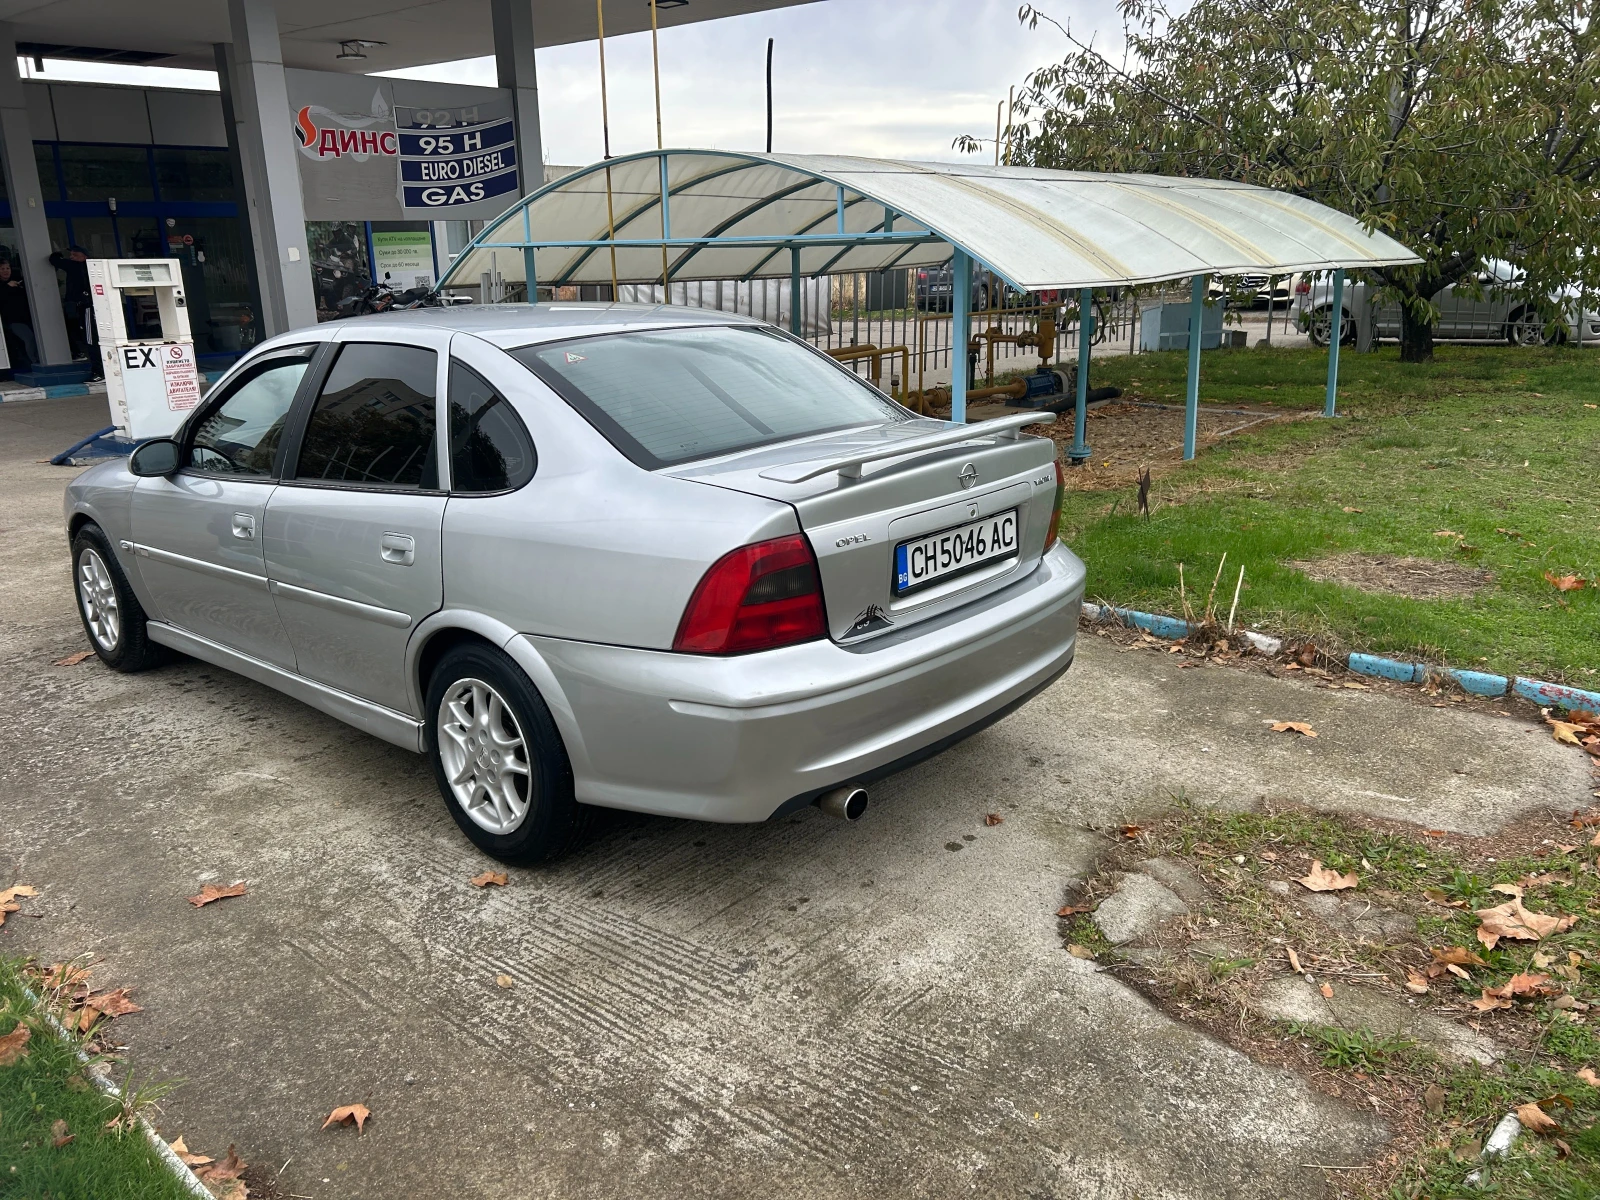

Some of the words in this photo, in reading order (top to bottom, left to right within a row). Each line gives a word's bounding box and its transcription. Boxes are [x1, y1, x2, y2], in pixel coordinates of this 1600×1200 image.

[419, 136, 454, 155] 95
[463, 131, 481, 151] H
[421, 161, 460, 180] EURO
[462, 152, 505, 177] DIESEL
[421, 182, 485, 205] GAS
[124, 348, 156, 369] EX
[835, 532, 872, 548] OPEL
[898, 572, 908, 584] BG
